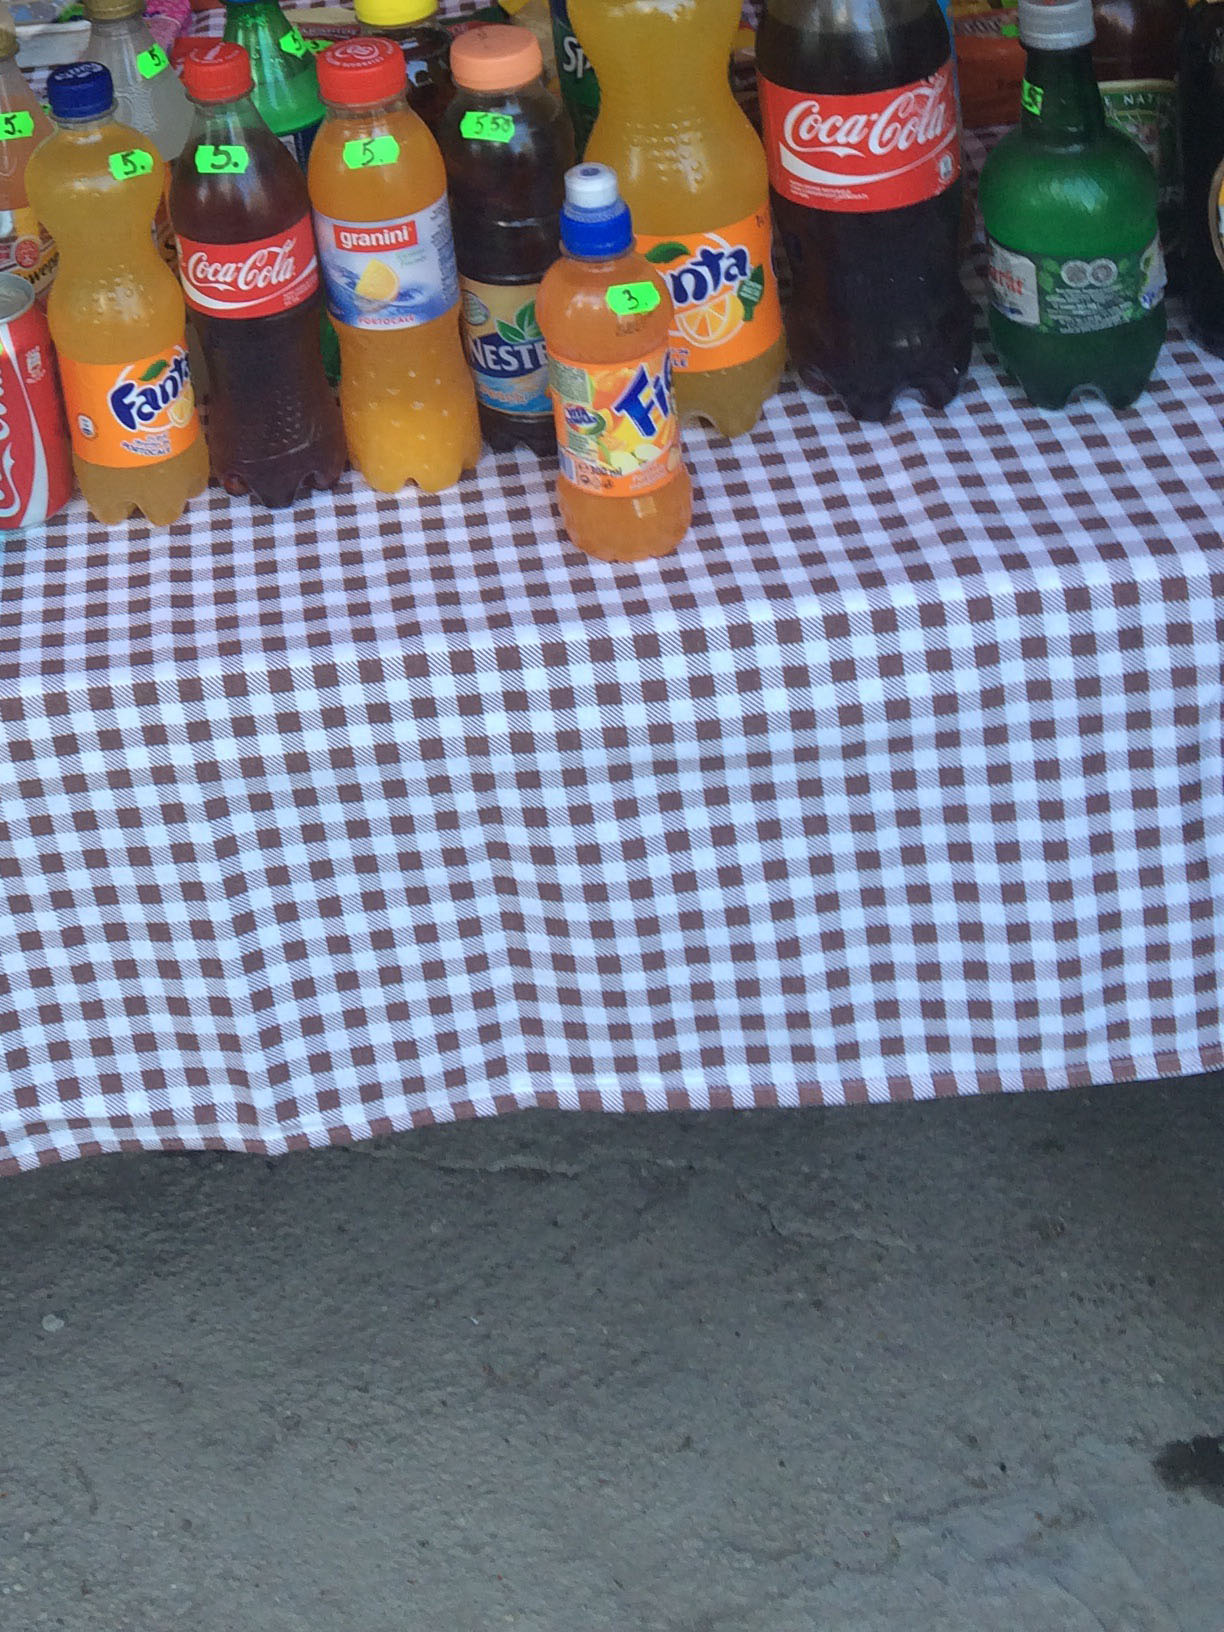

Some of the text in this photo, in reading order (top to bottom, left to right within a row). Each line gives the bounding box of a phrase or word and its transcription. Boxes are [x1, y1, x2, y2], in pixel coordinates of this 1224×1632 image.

[783, 82, 947, 158] Coca-Cola
[187, 236, 297, 292] Coca-Cola
[340, 225, 411, 249] granini
[670, 247, 749, 305] nta
[472, 336, 549, 370] NESTE
